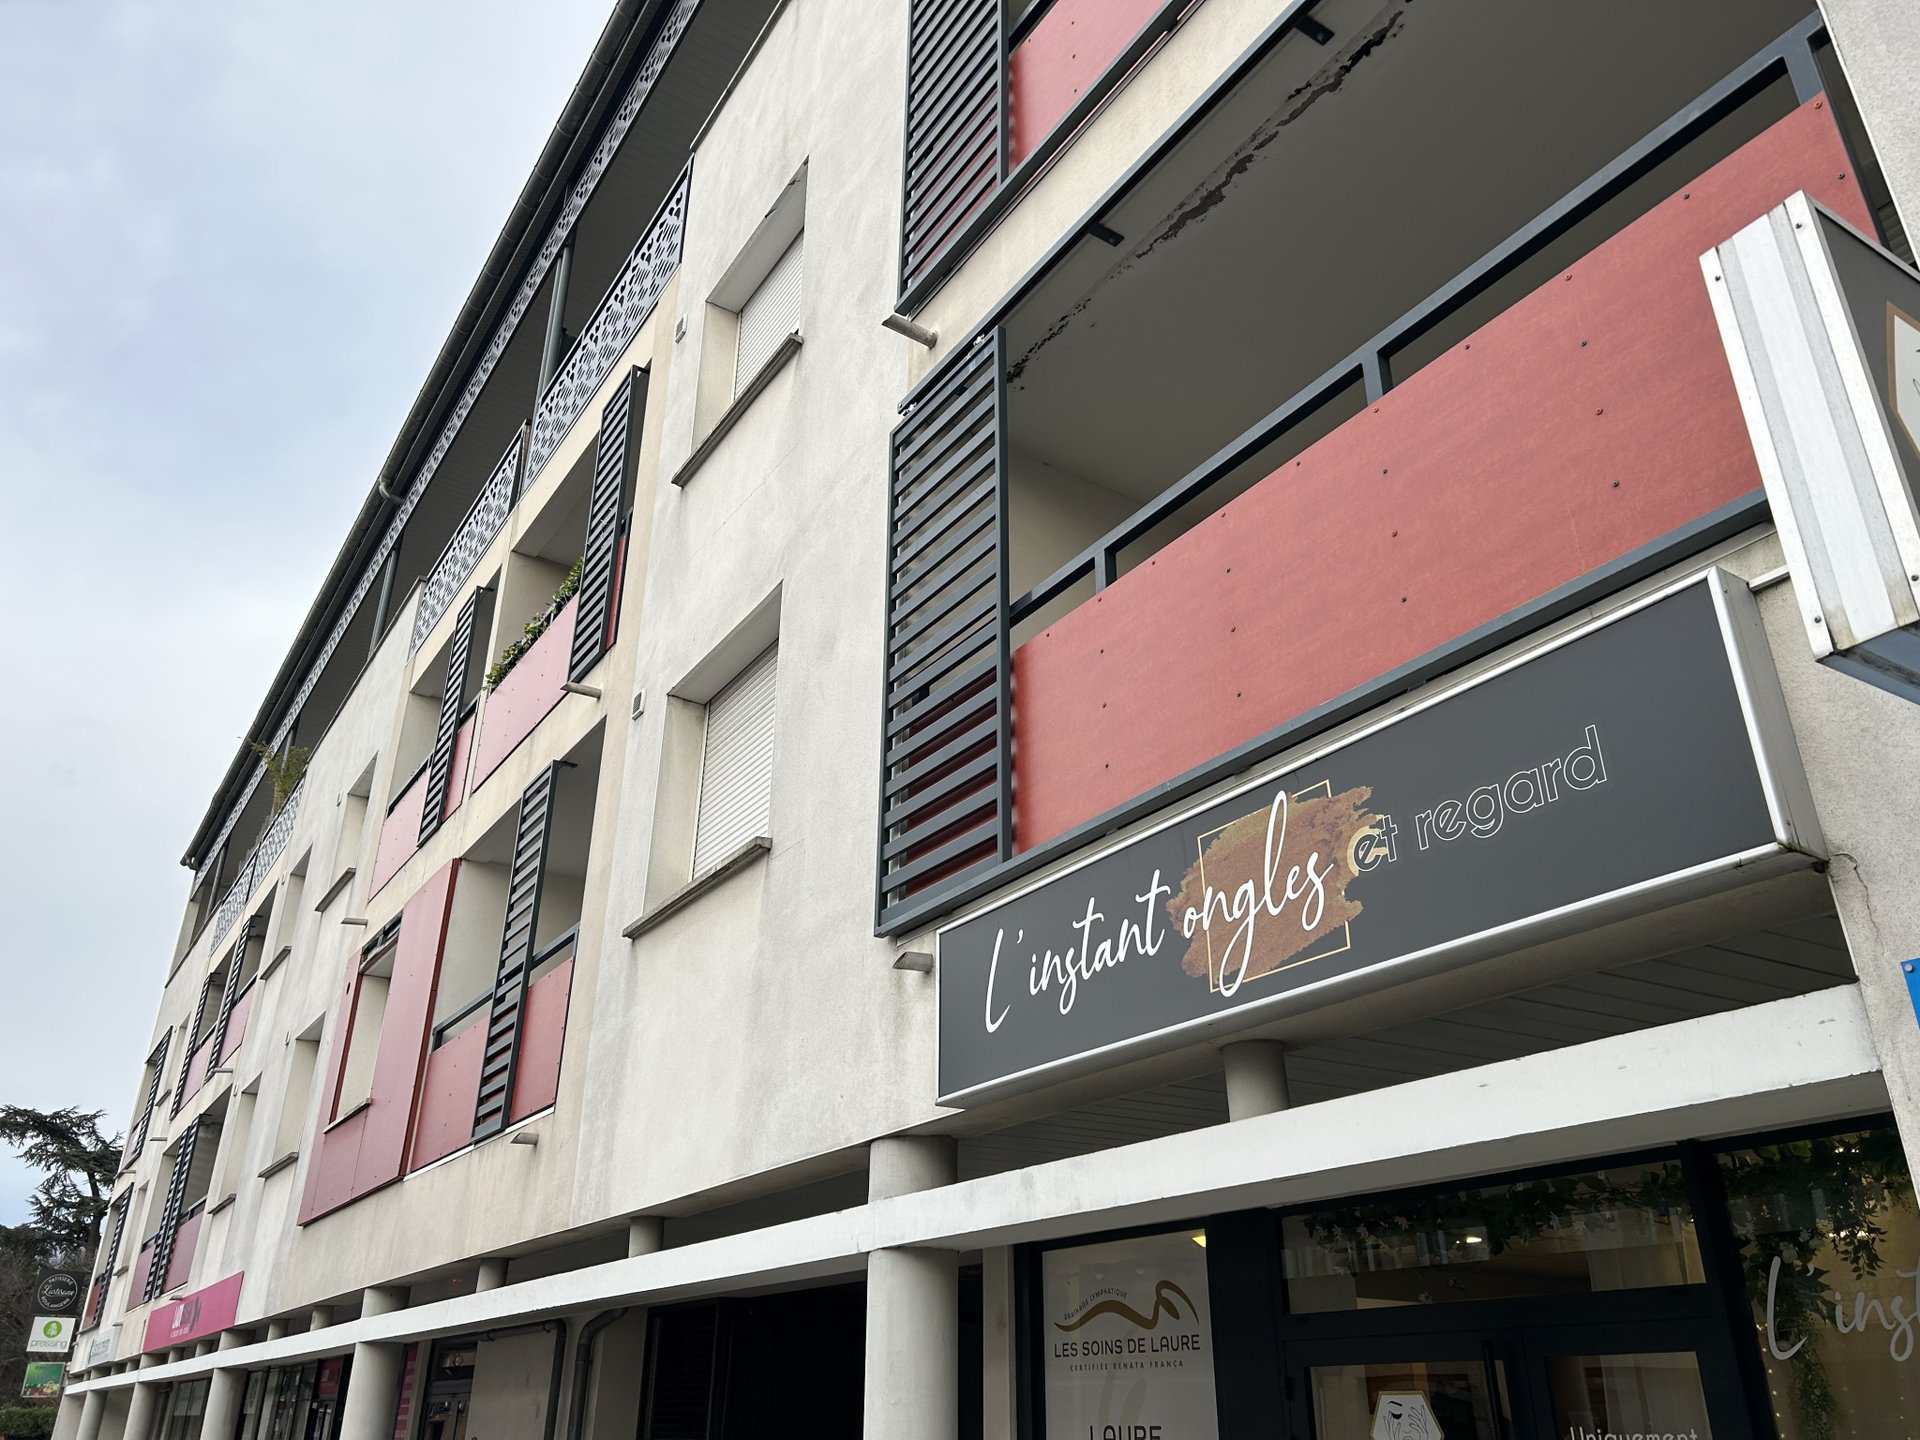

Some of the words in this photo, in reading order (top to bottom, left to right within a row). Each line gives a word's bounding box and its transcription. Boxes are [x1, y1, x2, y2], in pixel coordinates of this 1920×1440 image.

[985, 869, 1171, 1033] L'instant
[1183, 790, 1334, 997] ongles
[1353, 814, 1398, 872] et
[1415, 724, 1607, 851] regard
[1089, 1287, 1128, 1302] LYMPHATIQUE
[31, 1340, 68, 1350] pressing
[1054, 1342, 1078, 1358] LES
[1082, 1339, 1123, 1356] SOINS
[1127, 1337, 1146, 1354] DE
[1150, 1334, 1201, 1353] LAURE
[1113, 1360, 1145, 1370] RENATA
[1149, 1359, 1184, 1369] FRANÇA
